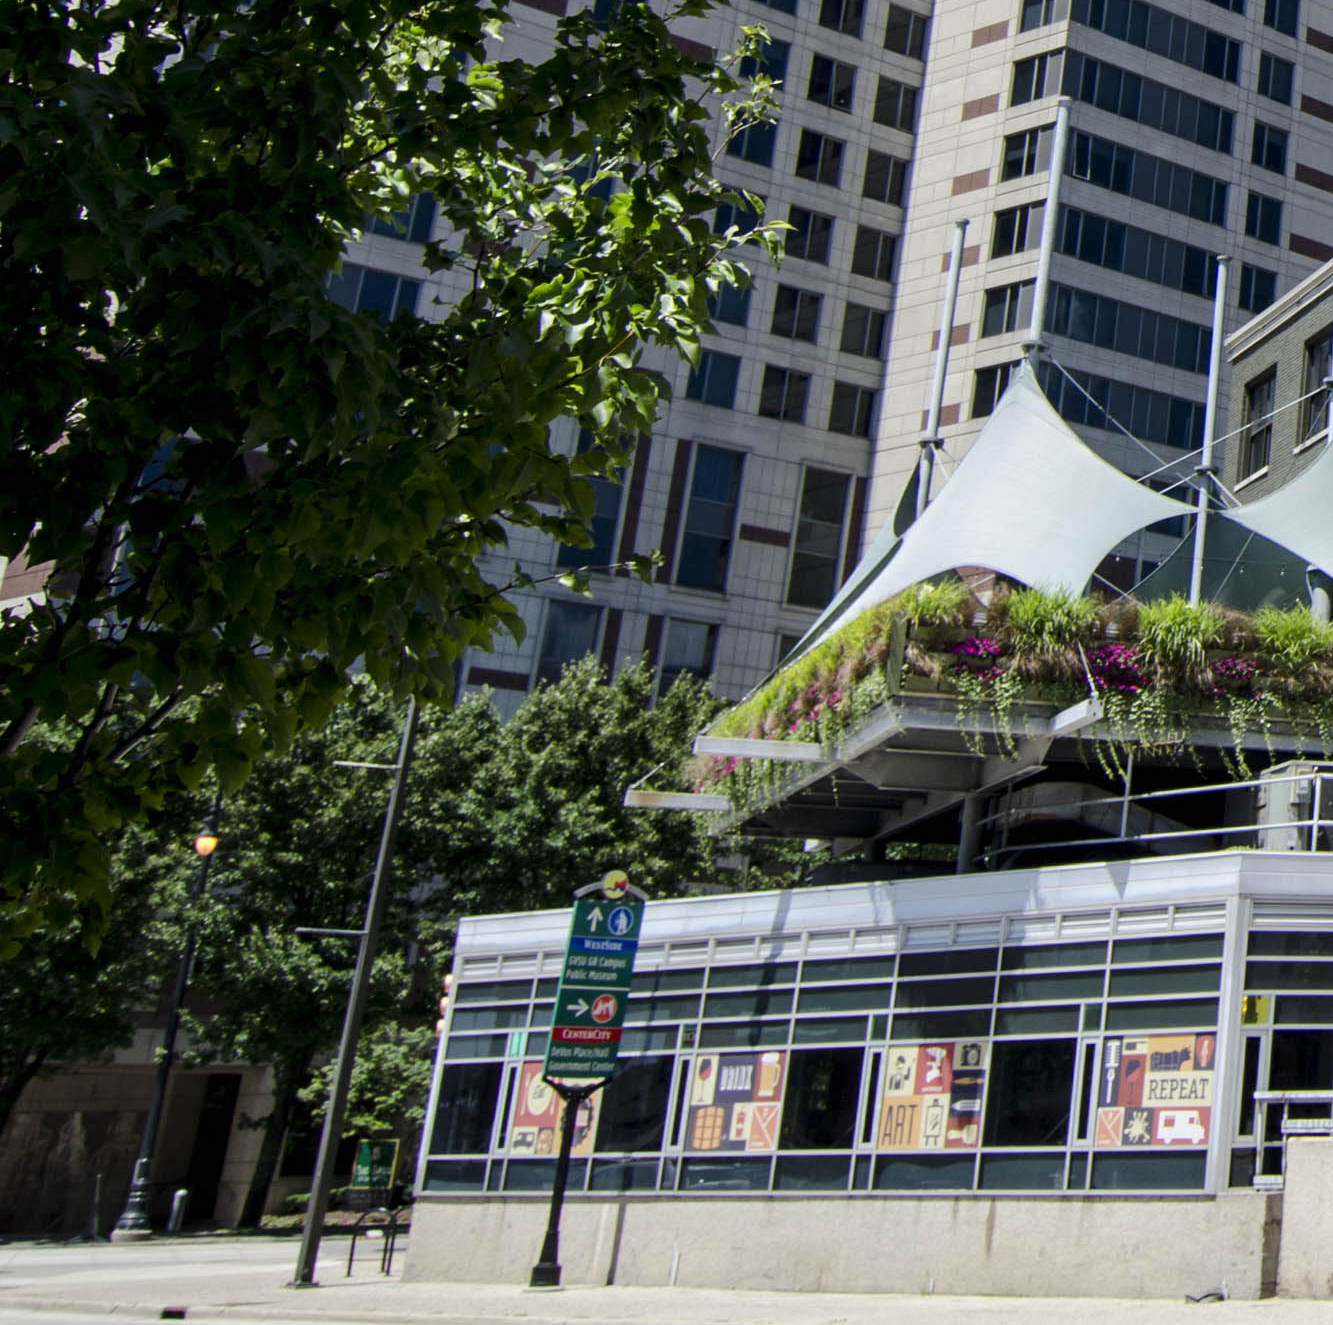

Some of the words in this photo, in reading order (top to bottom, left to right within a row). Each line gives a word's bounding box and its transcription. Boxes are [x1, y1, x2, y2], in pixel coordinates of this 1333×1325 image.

[599, 957, 627, 969] Campus
[566, 969, 587, 980] Public
[588, 970, 618, 981] Museum
[592, 1061, 616, 1072] Center
[1147, 1077, 1210, 1101] REPEAT
[881, 1104, 918, 1148] ART
